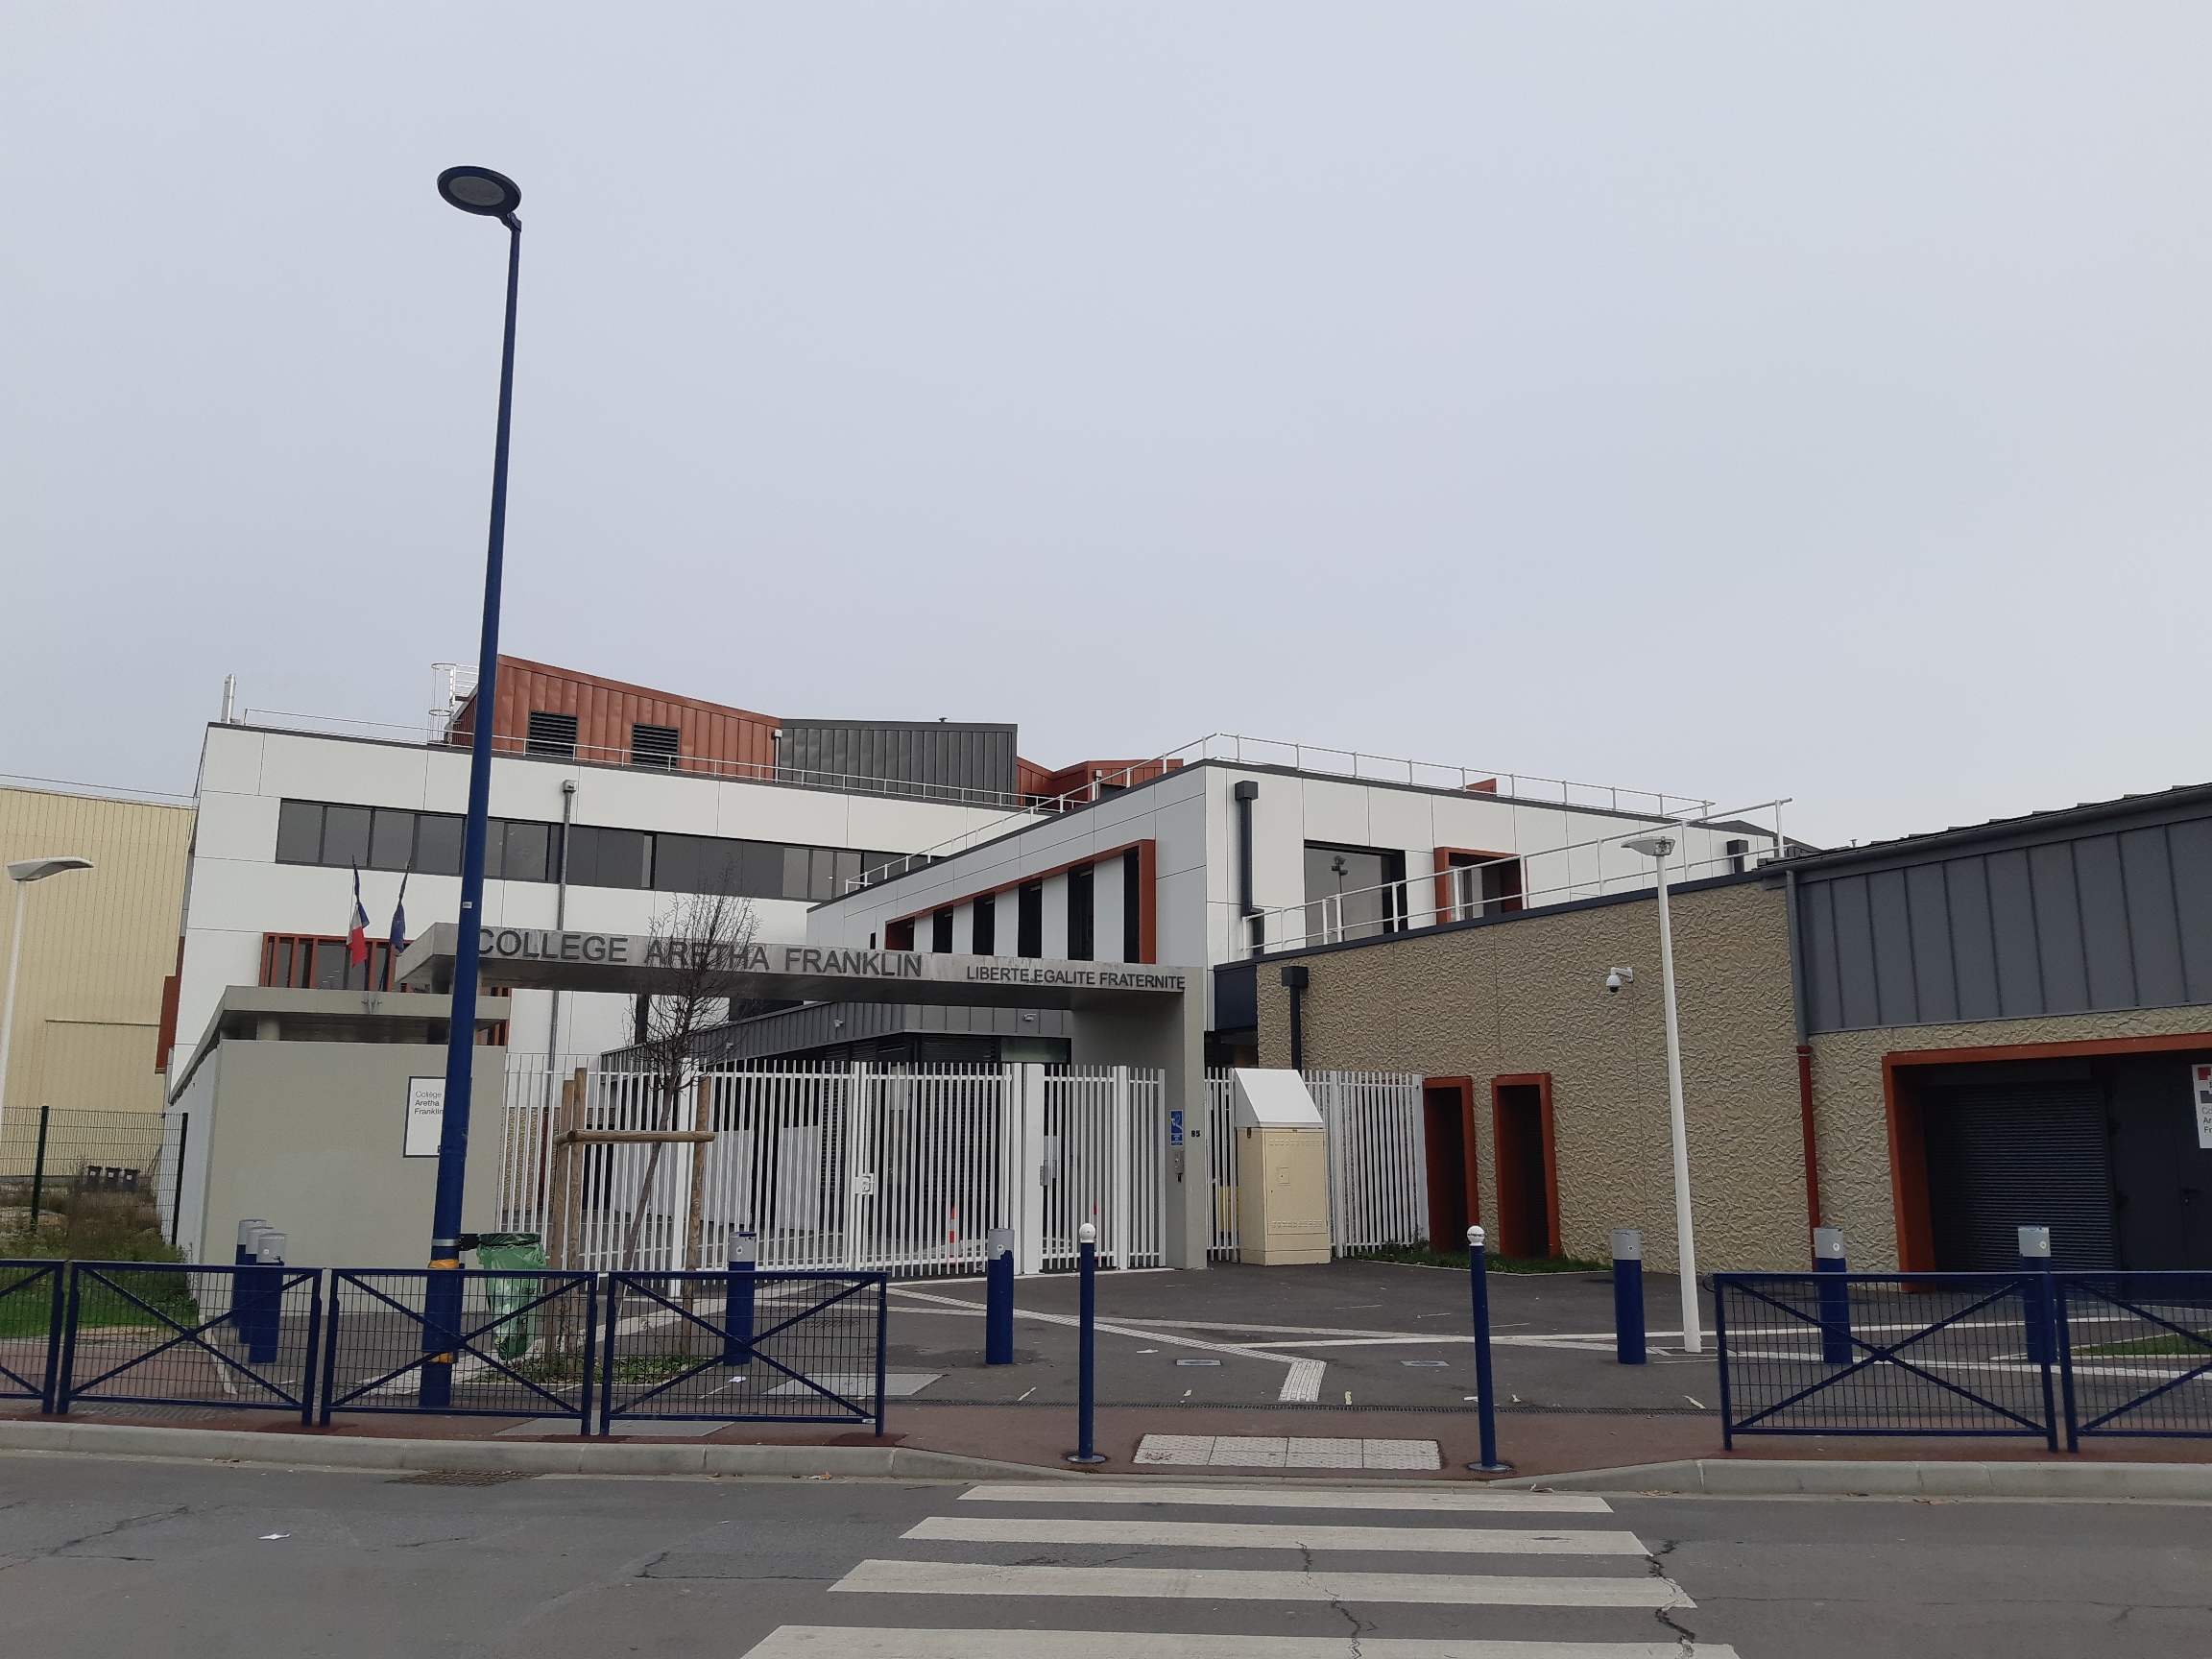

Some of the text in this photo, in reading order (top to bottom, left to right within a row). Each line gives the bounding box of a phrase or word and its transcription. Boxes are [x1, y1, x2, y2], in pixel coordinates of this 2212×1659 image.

[478, 928, 628, 962] COLLEGE
[785, 948, 922, 976] FRANKLIN
[1099, 973, 1186, 990] FRATERNITE
